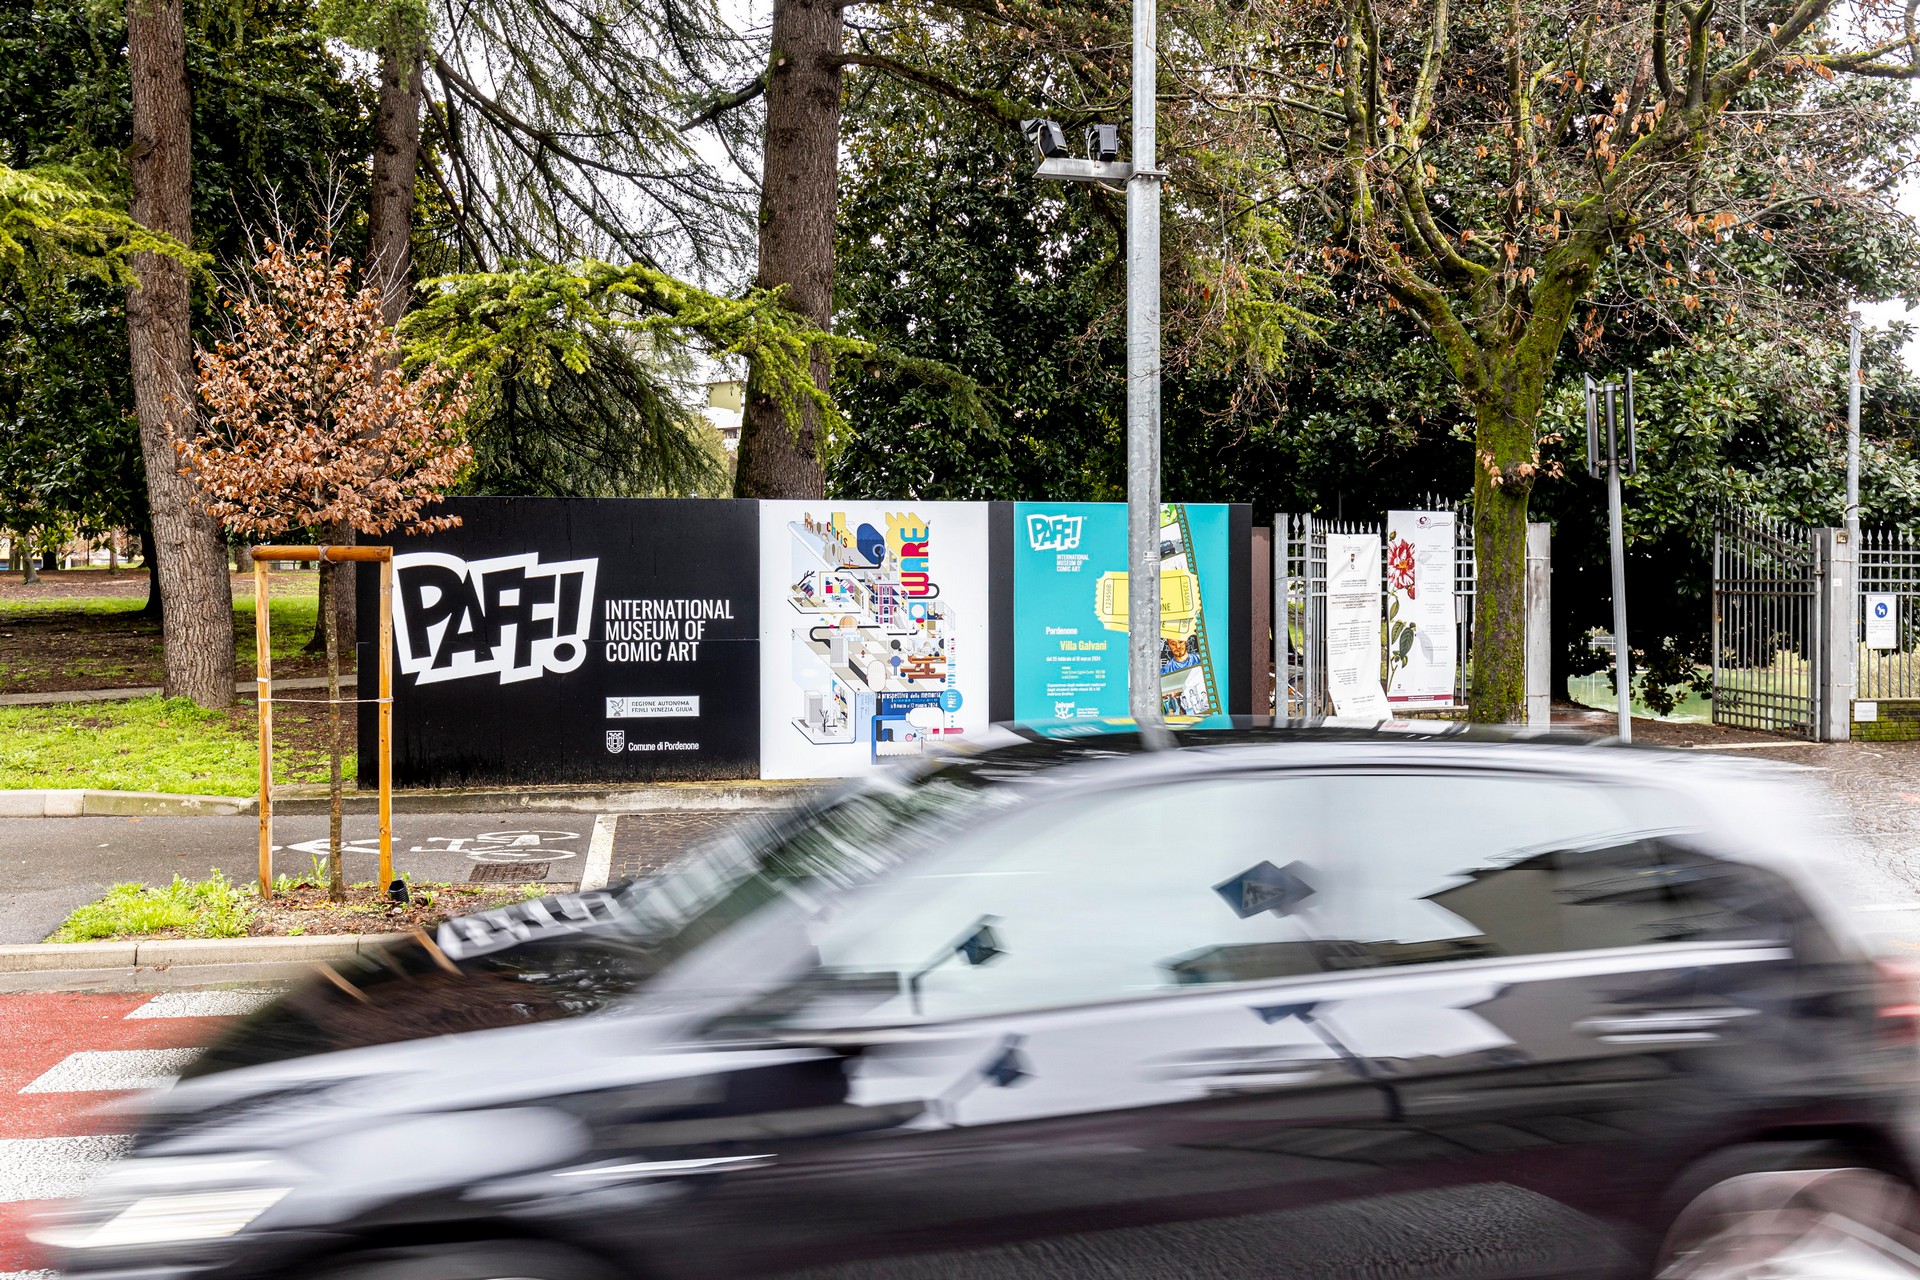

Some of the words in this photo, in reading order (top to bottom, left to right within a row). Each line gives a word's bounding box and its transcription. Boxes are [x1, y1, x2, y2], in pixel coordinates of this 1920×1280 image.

[826, 516, 848, 548] chris
[1028, 515, 1081, 550] PAFF!
[901, 527, 929, 596] WARE
[394, 556, 594, 680] PAFF!
[605, 600, 734, 619] INTERNATIONAL
[605, 621, 679, 641] MUSEUM
[684, 620, 706, 640] OF
[605, 642, 662, 662] COMIC
[666, 641, 700, 662] ART
[1060, 641, 1077, 650] Villa
[1078, 640, 1107, 650] Galvani
[628, 742, 656, 751] Comune
[657, 741, 663, 751] di
[664, 741, 700, 751] Pordenone
